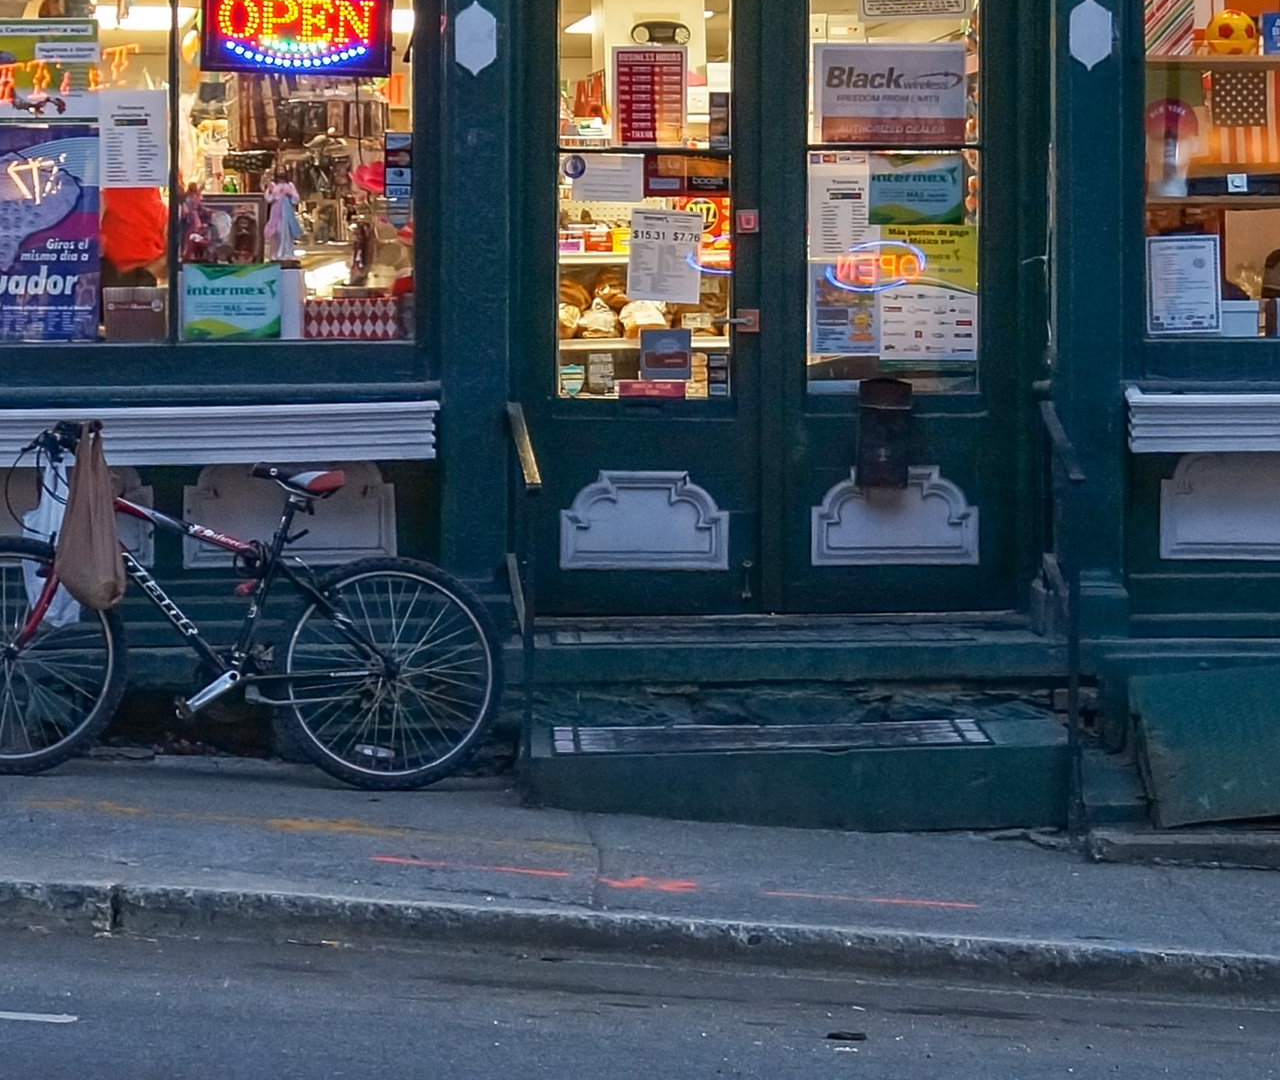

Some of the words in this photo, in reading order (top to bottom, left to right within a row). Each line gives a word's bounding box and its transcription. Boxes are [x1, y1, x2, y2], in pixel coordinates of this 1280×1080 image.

[825, 66, 905, 89] Black
[903, 78, 949, 90] wireless
[838, 123, 904, 134] AUTHORIZED
[905, 124, 946, 134] DEALER
[632, 229, 666, 241] $15.31
[672, 231, 701, 243] $7.76
[20, 251, 57, 262] mismo
[80, 252, 89, 262] a
[186, 284, 266, 296] intermex
